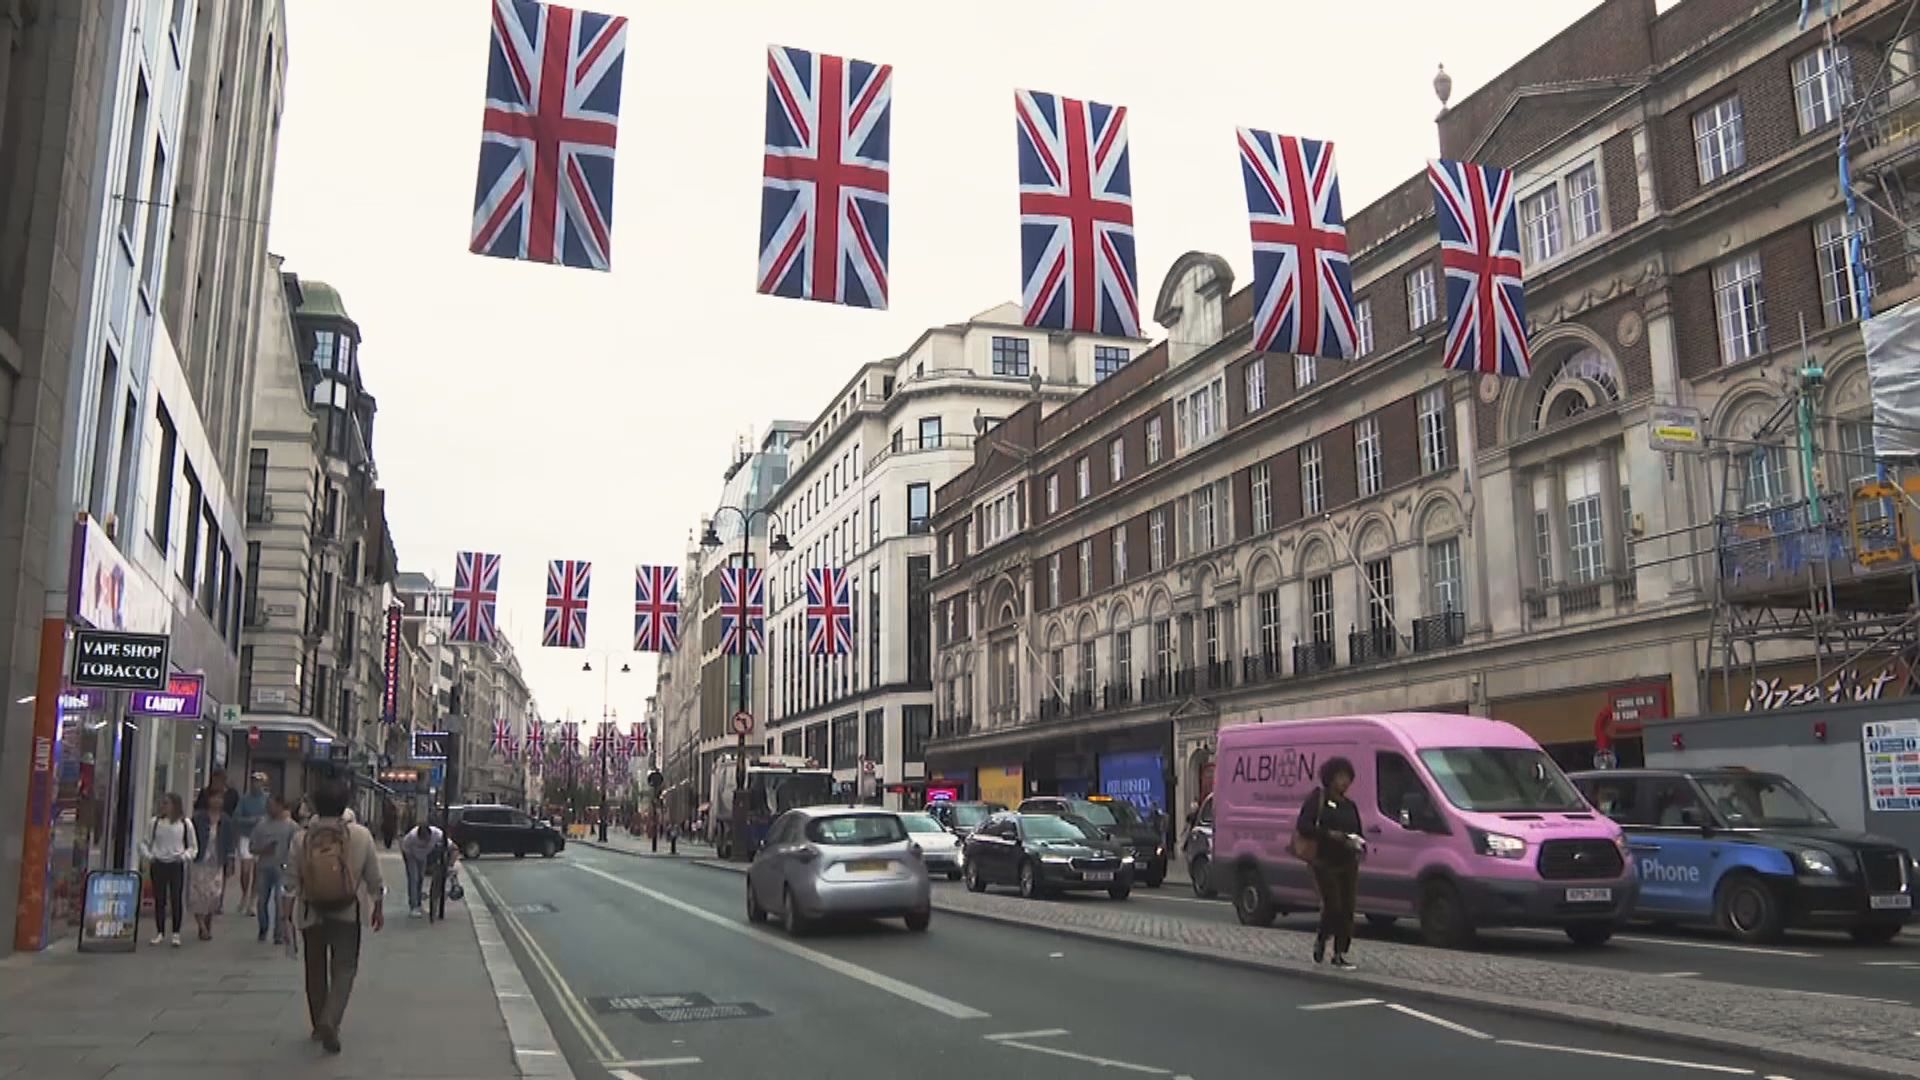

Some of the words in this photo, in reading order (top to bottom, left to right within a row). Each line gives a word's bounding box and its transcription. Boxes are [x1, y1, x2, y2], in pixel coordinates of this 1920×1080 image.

[84, 641, 120, 657] VAPE
[122, 643, 161, 659] SHOP
[82, 662, 159, 679] TOBACCO
[1744, 677, 1820, 712] Pizza
[145, 695, 185, 713] CANDY
[1642, 857, 1700, 882] Phone
